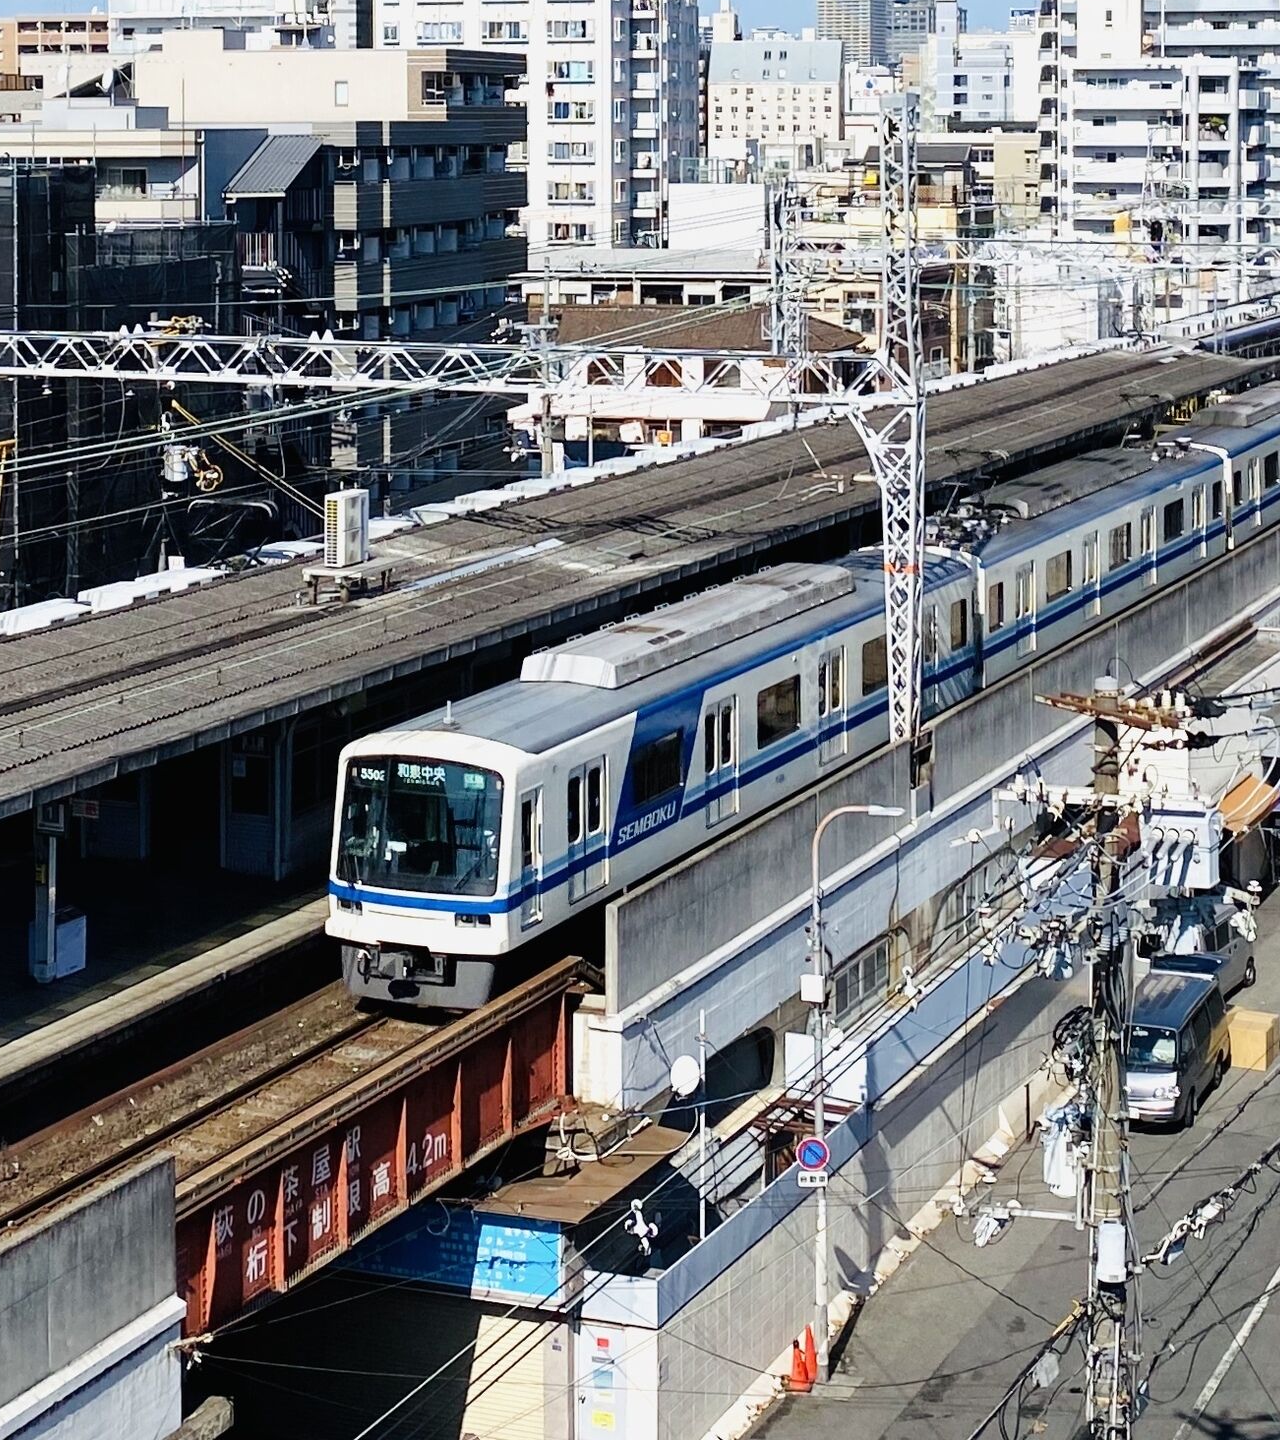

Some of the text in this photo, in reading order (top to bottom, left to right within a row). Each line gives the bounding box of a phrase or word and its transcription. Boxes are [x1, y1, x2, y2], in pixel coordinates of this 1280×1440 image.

[397, 763, 447, 782] 和泉中央
[617, 800, 677, 846] SEMBOKU
[405, 1132, 448, 1177] 4.2m
